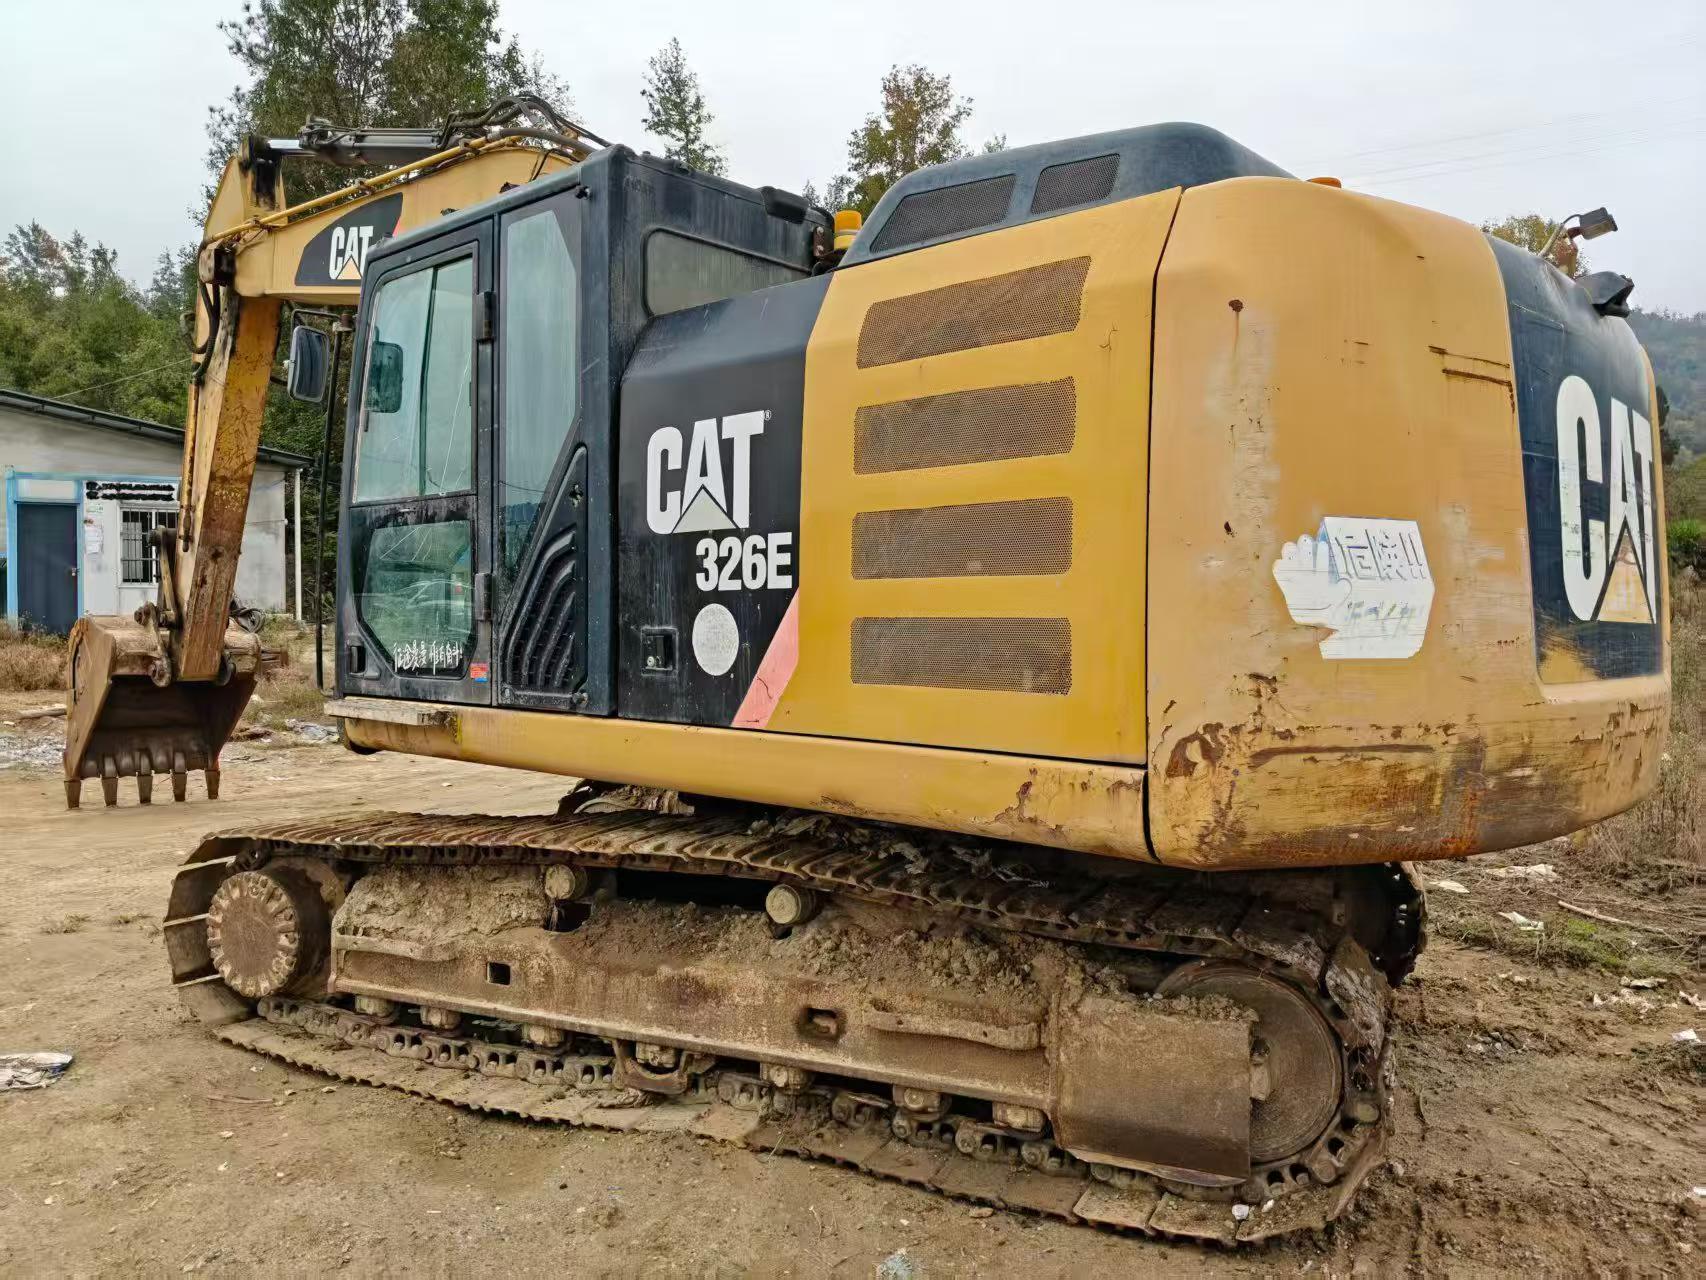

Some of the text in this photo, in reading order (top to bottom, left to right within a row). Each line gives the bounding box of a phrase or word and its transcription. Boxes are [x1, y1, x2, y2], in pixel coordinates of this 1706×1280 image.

[329, 225, 374, 280] CAT
[646, 409, 765, 535] CAT
[1556, 375, 1657, 625] CAT
[695, 531, 793, 592] 326E
